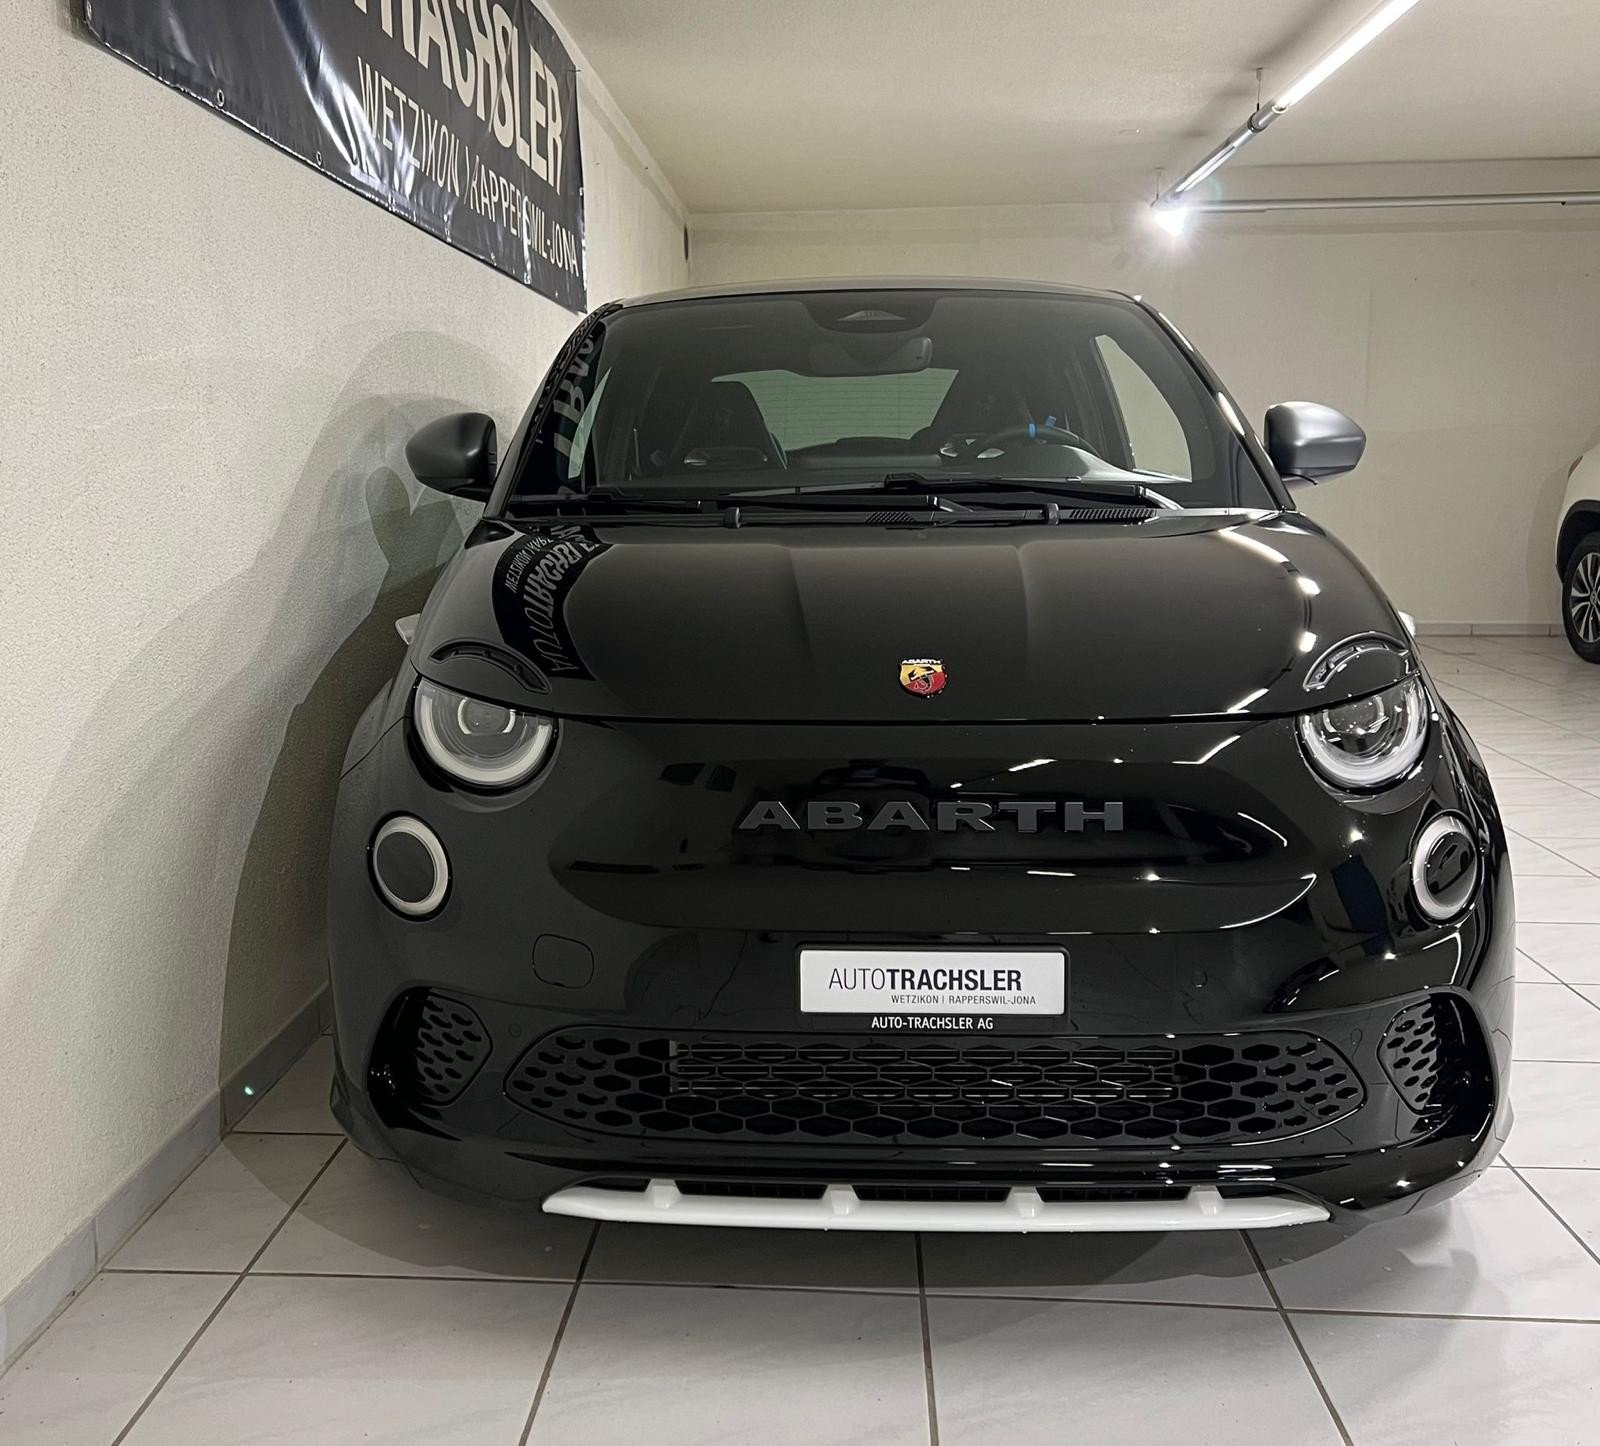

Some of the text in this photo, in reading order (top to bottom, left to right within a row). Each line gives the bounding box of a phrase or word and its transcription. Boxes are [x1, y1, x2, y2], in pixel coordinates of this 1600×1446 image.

[357, 56, 460, 198] WETZIKON
[738, 801, 1124, 833] ABARTH
[828, 967, 1023, 991] AUTOTRACHSLER
[891, 995, 939, 1004] WETZIKON
[948, 995, 1036, 1005] RAPPERSWIL-JONA
[871, 1016, 994, 1030] AUTO-TRACHSLER AG
